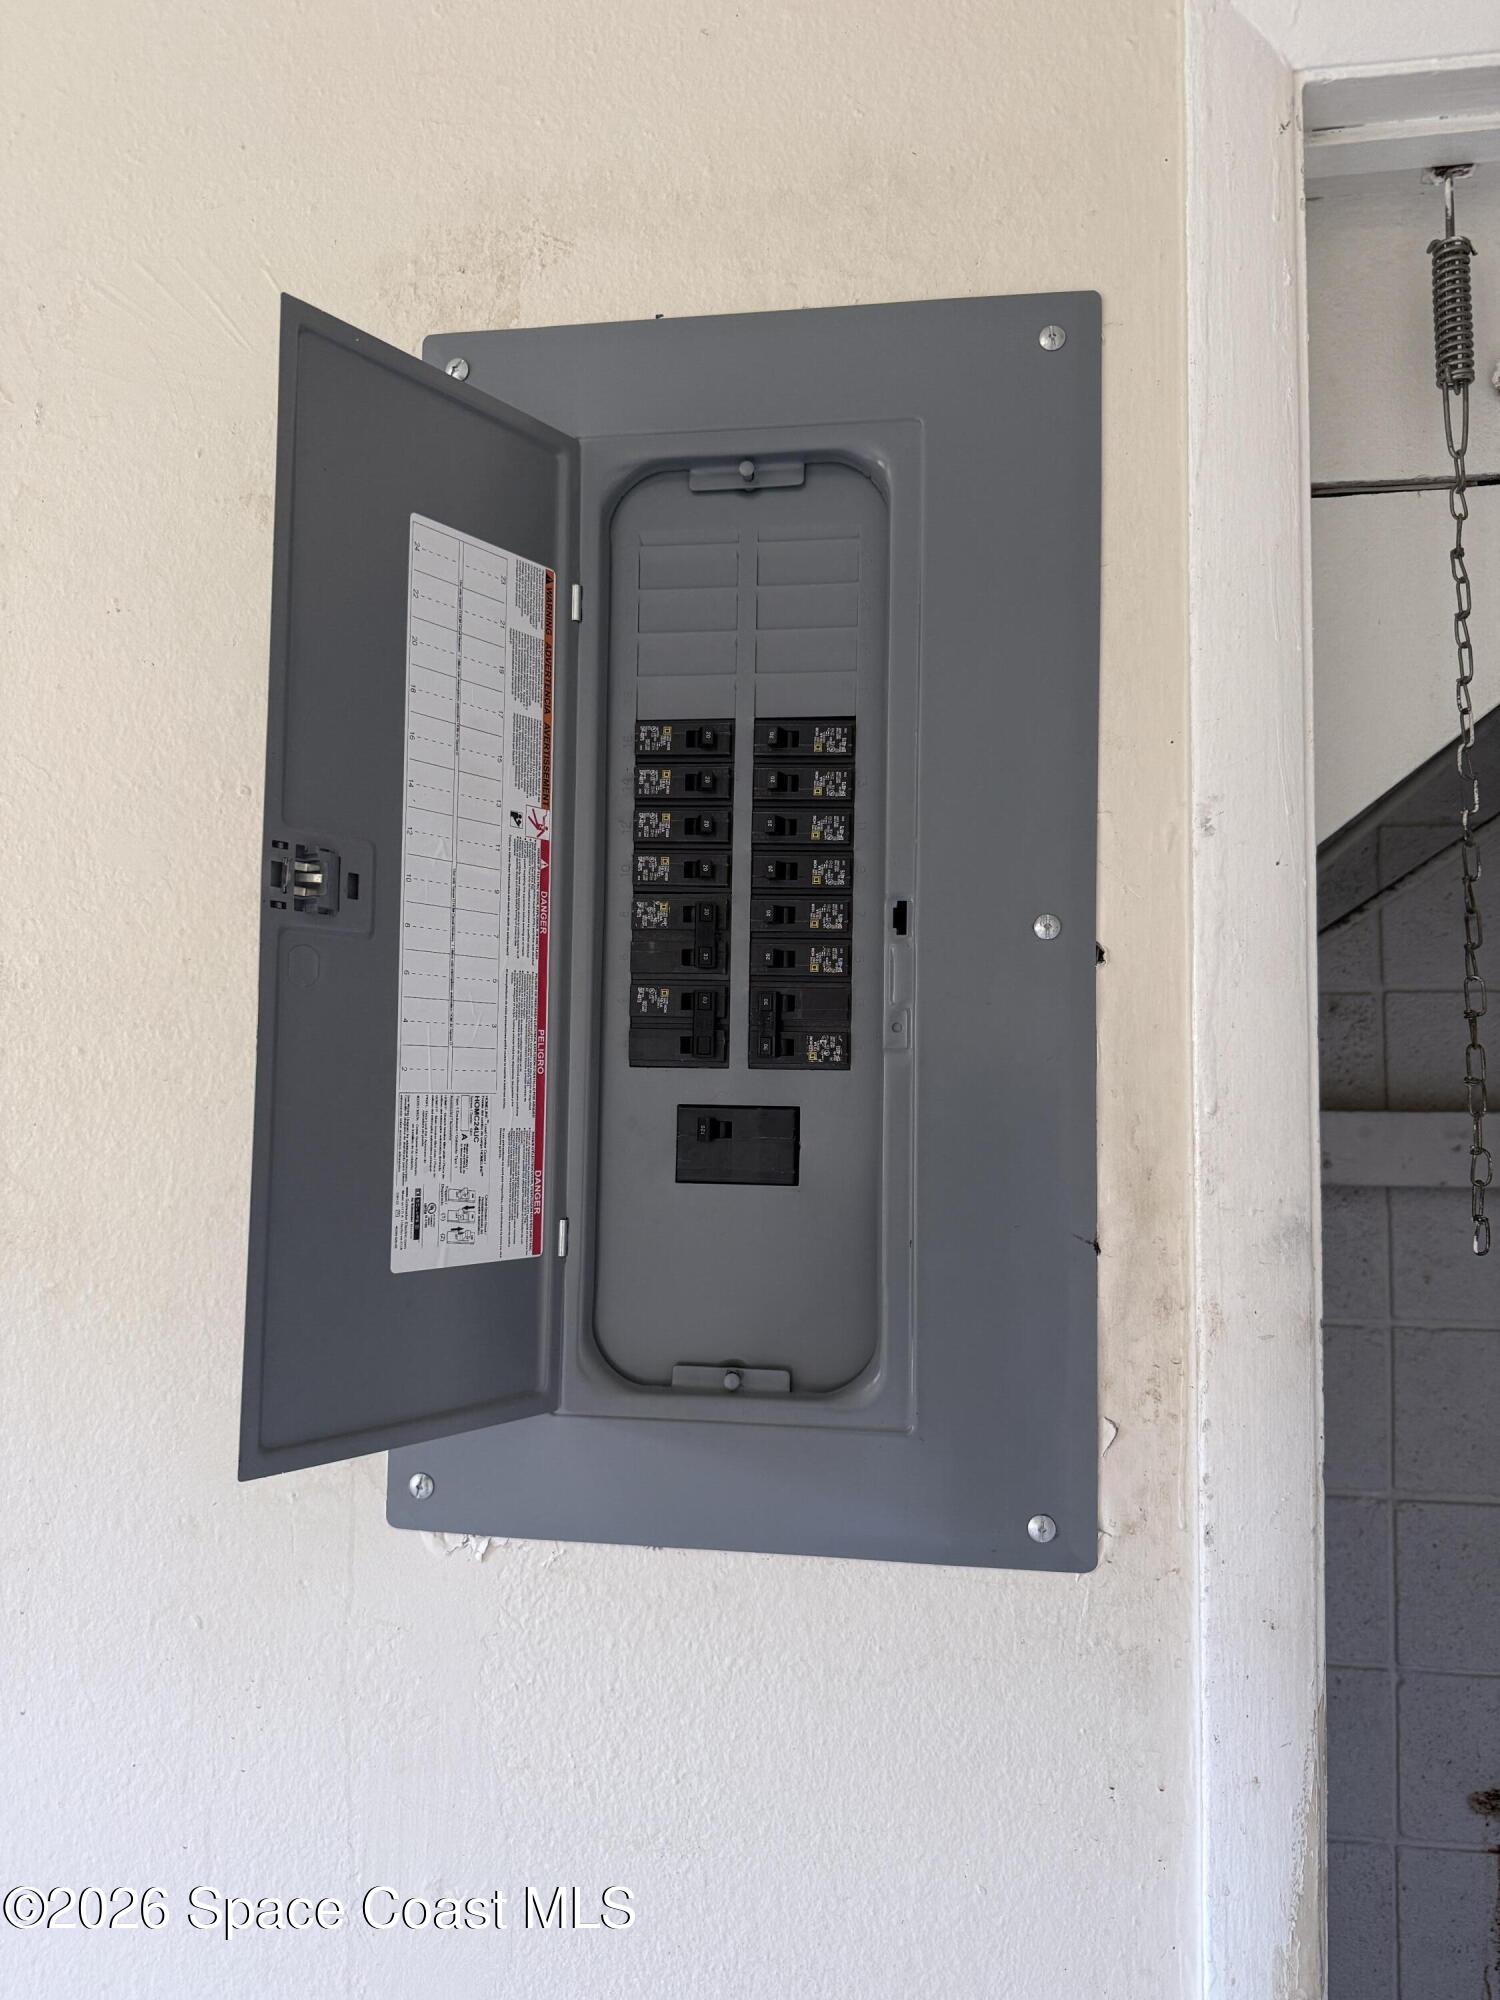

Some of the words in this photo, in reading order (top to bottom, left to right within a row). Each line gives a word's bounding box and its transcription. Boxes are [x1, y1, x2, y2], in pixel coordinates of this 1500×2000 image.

[412, 589, 419, 599] 22
[545, 588, 554, 635] WARNING
[500, 619, 505, 629] 21
[411, 636, 418, 646] 20
[543, 642, 552, 714] ADVERTENCIA
[410, 685, 416, 694] 18
[409, 732, 415, 741] 16
[408, 779, 414, 788] 14
[407, 827, 413, 836] 12
[406, 874, 411, 882] 10
[539, 891, 548, 934] DANGER
[534, 1170, 542, 1214] DANGER
